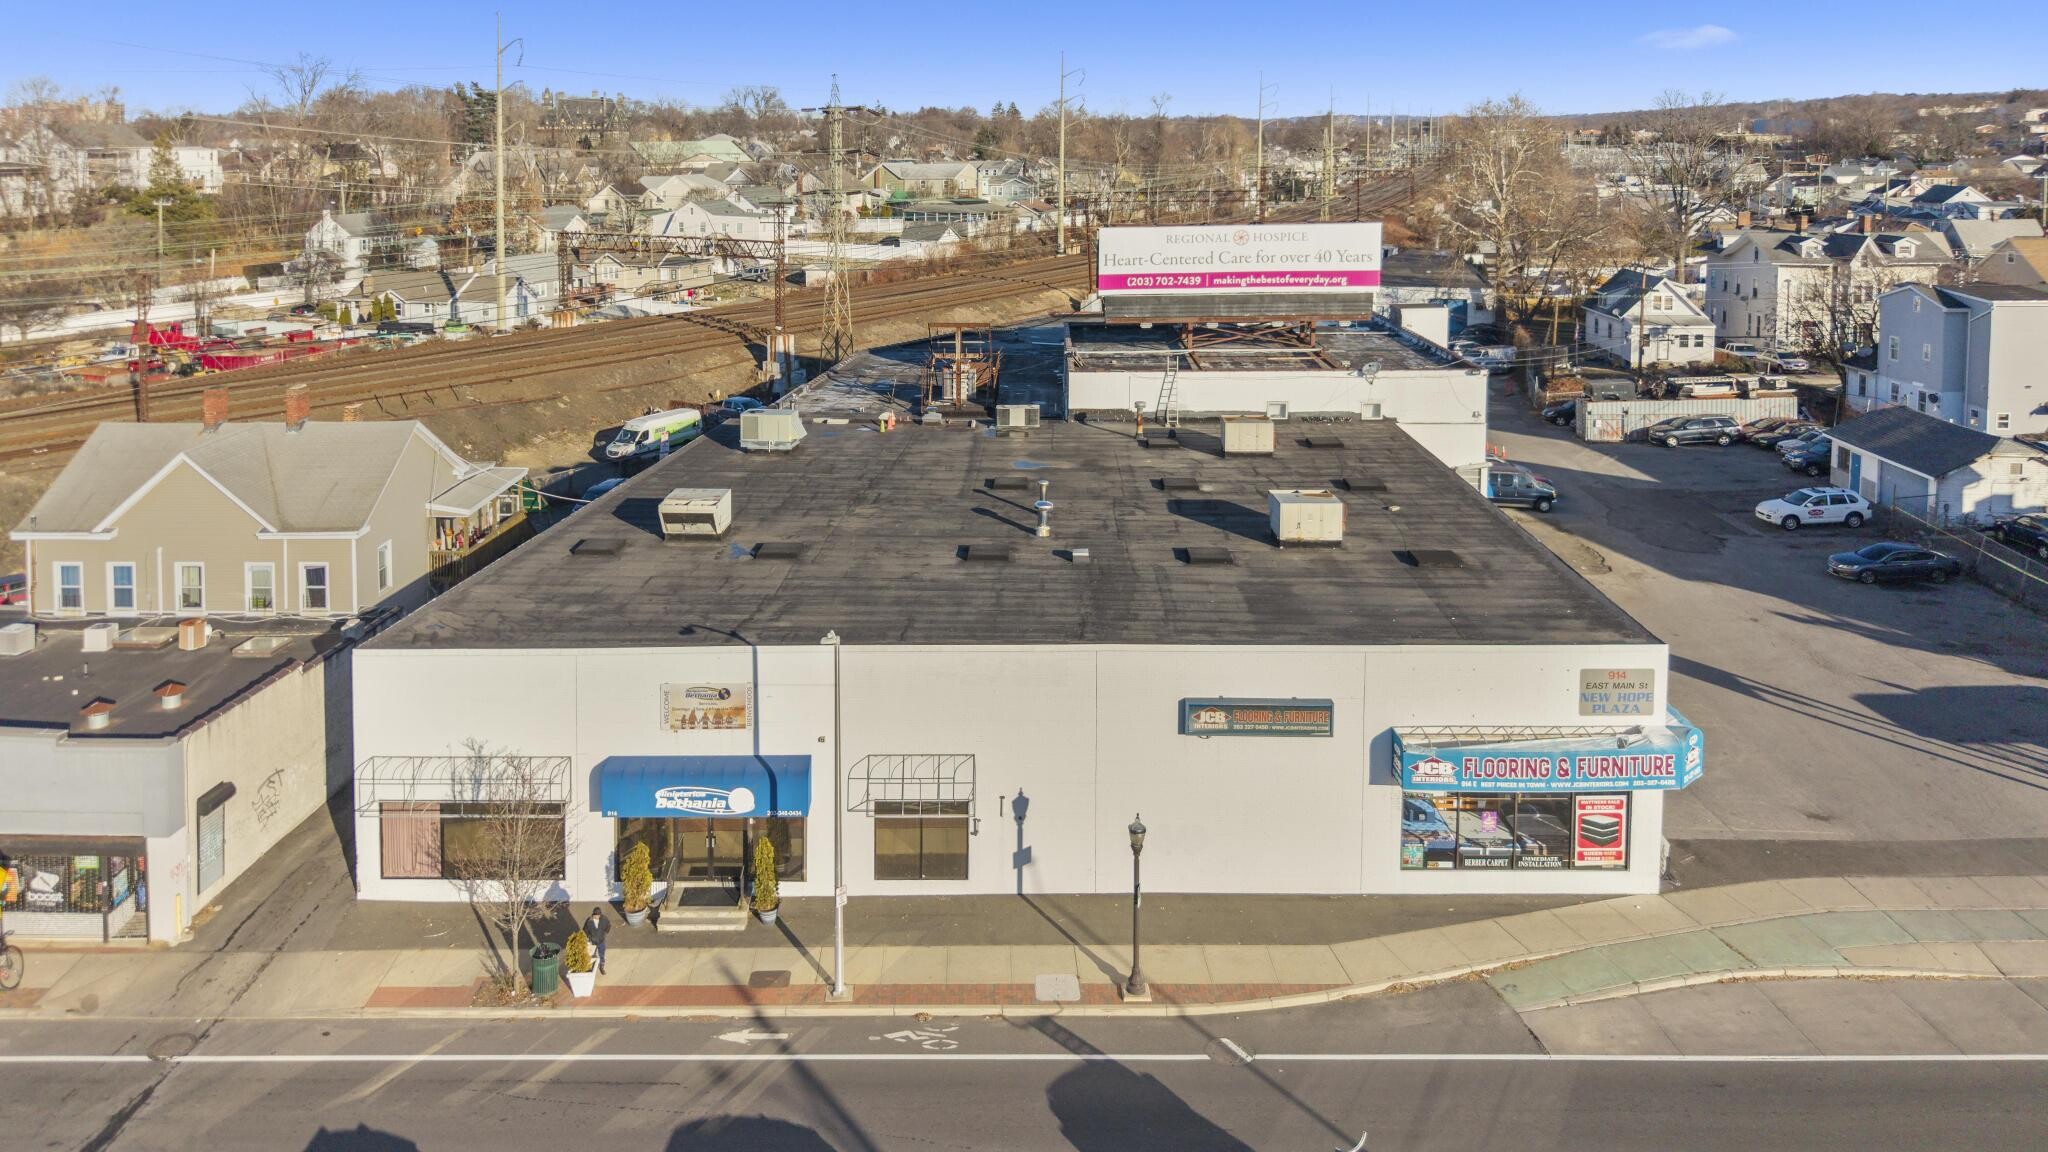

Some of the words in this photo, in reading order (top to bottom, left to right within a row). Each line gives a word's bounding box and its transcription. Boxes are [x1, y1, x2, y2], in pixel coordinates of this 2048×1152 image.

[1166, 232, 1230, 245] REGIONAL
[1253, 231, 1309, 243] HOSPICE
[1103, 251, 1214, 267] Heart-Centered
[1218, 250, 1252, 265] Care
[1256, 249, 1277, 264] for
[1280, 253, 1310, 263] over
[1313, 250, 1332, 263] 40
[1337, 249, 1373, 263] Years
[1127, 274, 1153, 287] (203)
[1155, 274, 1201, 286] 702-7439
[1213, 273, 1348, 288] makingthebestofeveryday.org
[1608, 671, 1626, 680] 914
[1585, 682, 1609, 690] EAST
[1612, 682, 1635, 690] MAIN
[1580, 692, 1612, 702] NEW
[1617, 692, 1654, 702] HOPE
[1592, 704, 1640, 714] PLAZA
[1199, 711, 1225, 723] JCB
[1233, 710, 1273, 723] FLOORING
[1275, 710, 1282, 723] &
[1284, 710, 1329, 723] FURNITURE
[1416, 761, 1453, 775] JCB
[1463, 757, 1551, 779] FLOORING
[1556, 756, 1571, 779] &
[1576, 754, 1675, 778] FURNITURE
[656, 797, 726, 809] Bethania
[1464, 858, 1486, 866] BERBER
[1486, 858, 1509, 866] CARPET
[26, 891, 64, 902] boost
